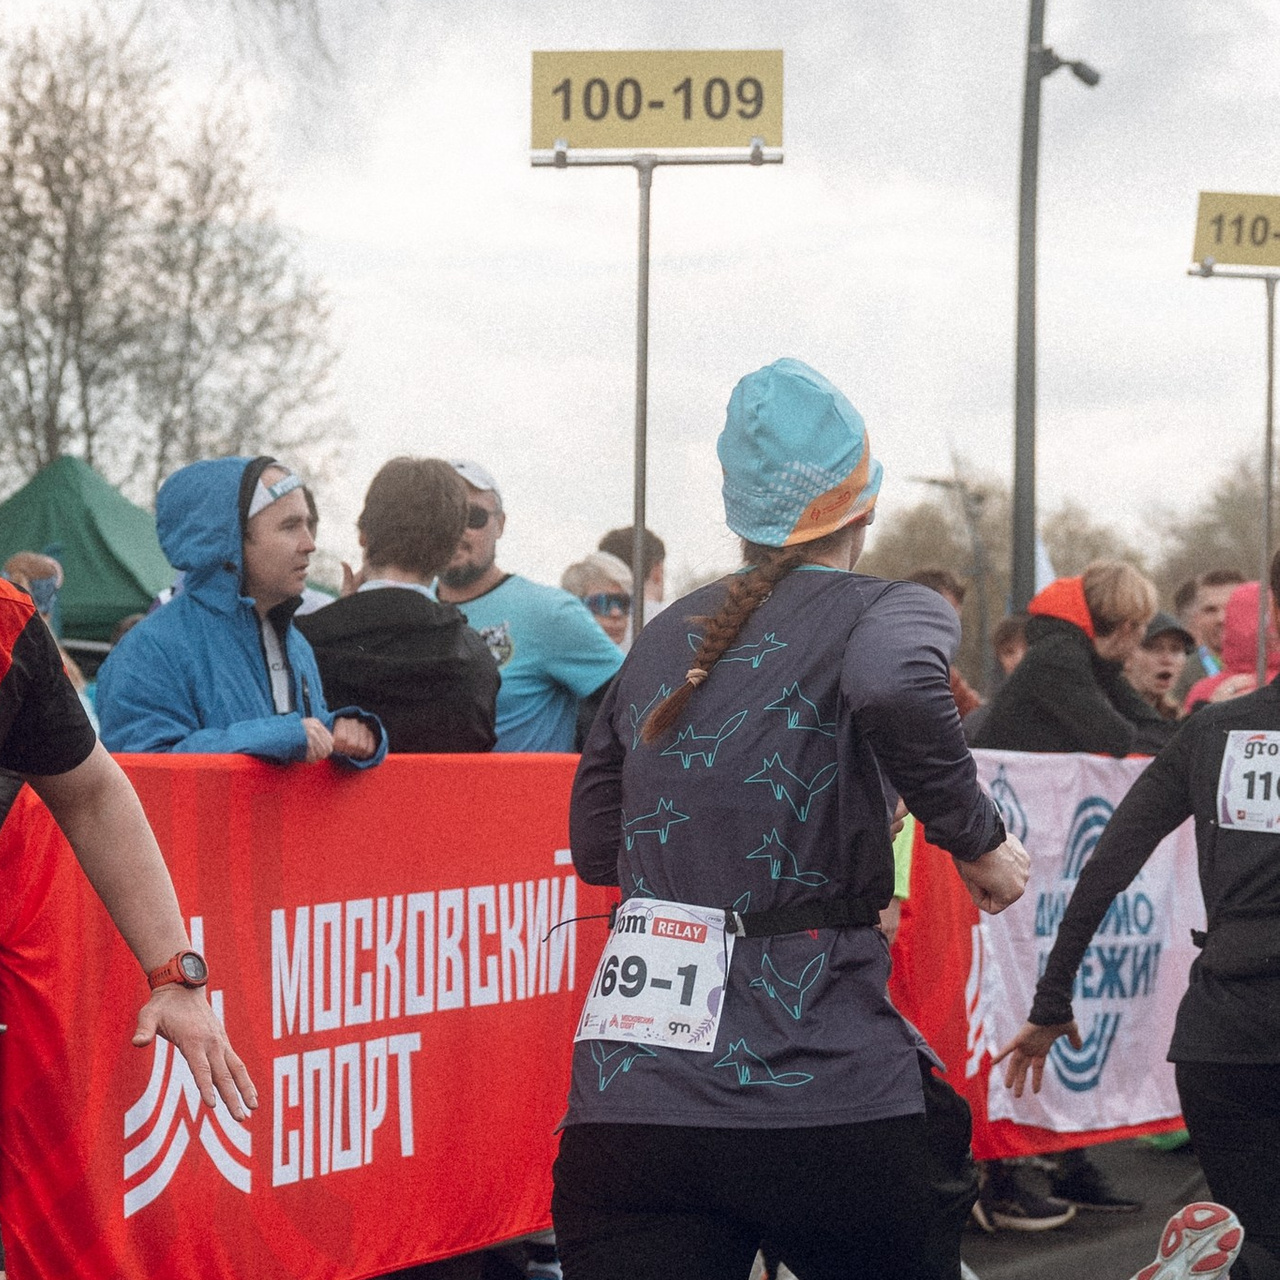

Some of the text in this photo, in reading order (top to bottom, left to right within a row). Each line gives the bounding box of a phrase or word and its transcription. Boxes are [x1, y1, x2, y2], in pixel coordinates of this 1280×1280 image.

[552, 76, 764, 121] 100-109
[1243, 770, 1280, 801] 11
[271, 848, 577, 1040] МОСКОВСКИЙ
[657, 920, 702, 940] RELAY
[272, 1031, 422, 1187] СПОРТ
